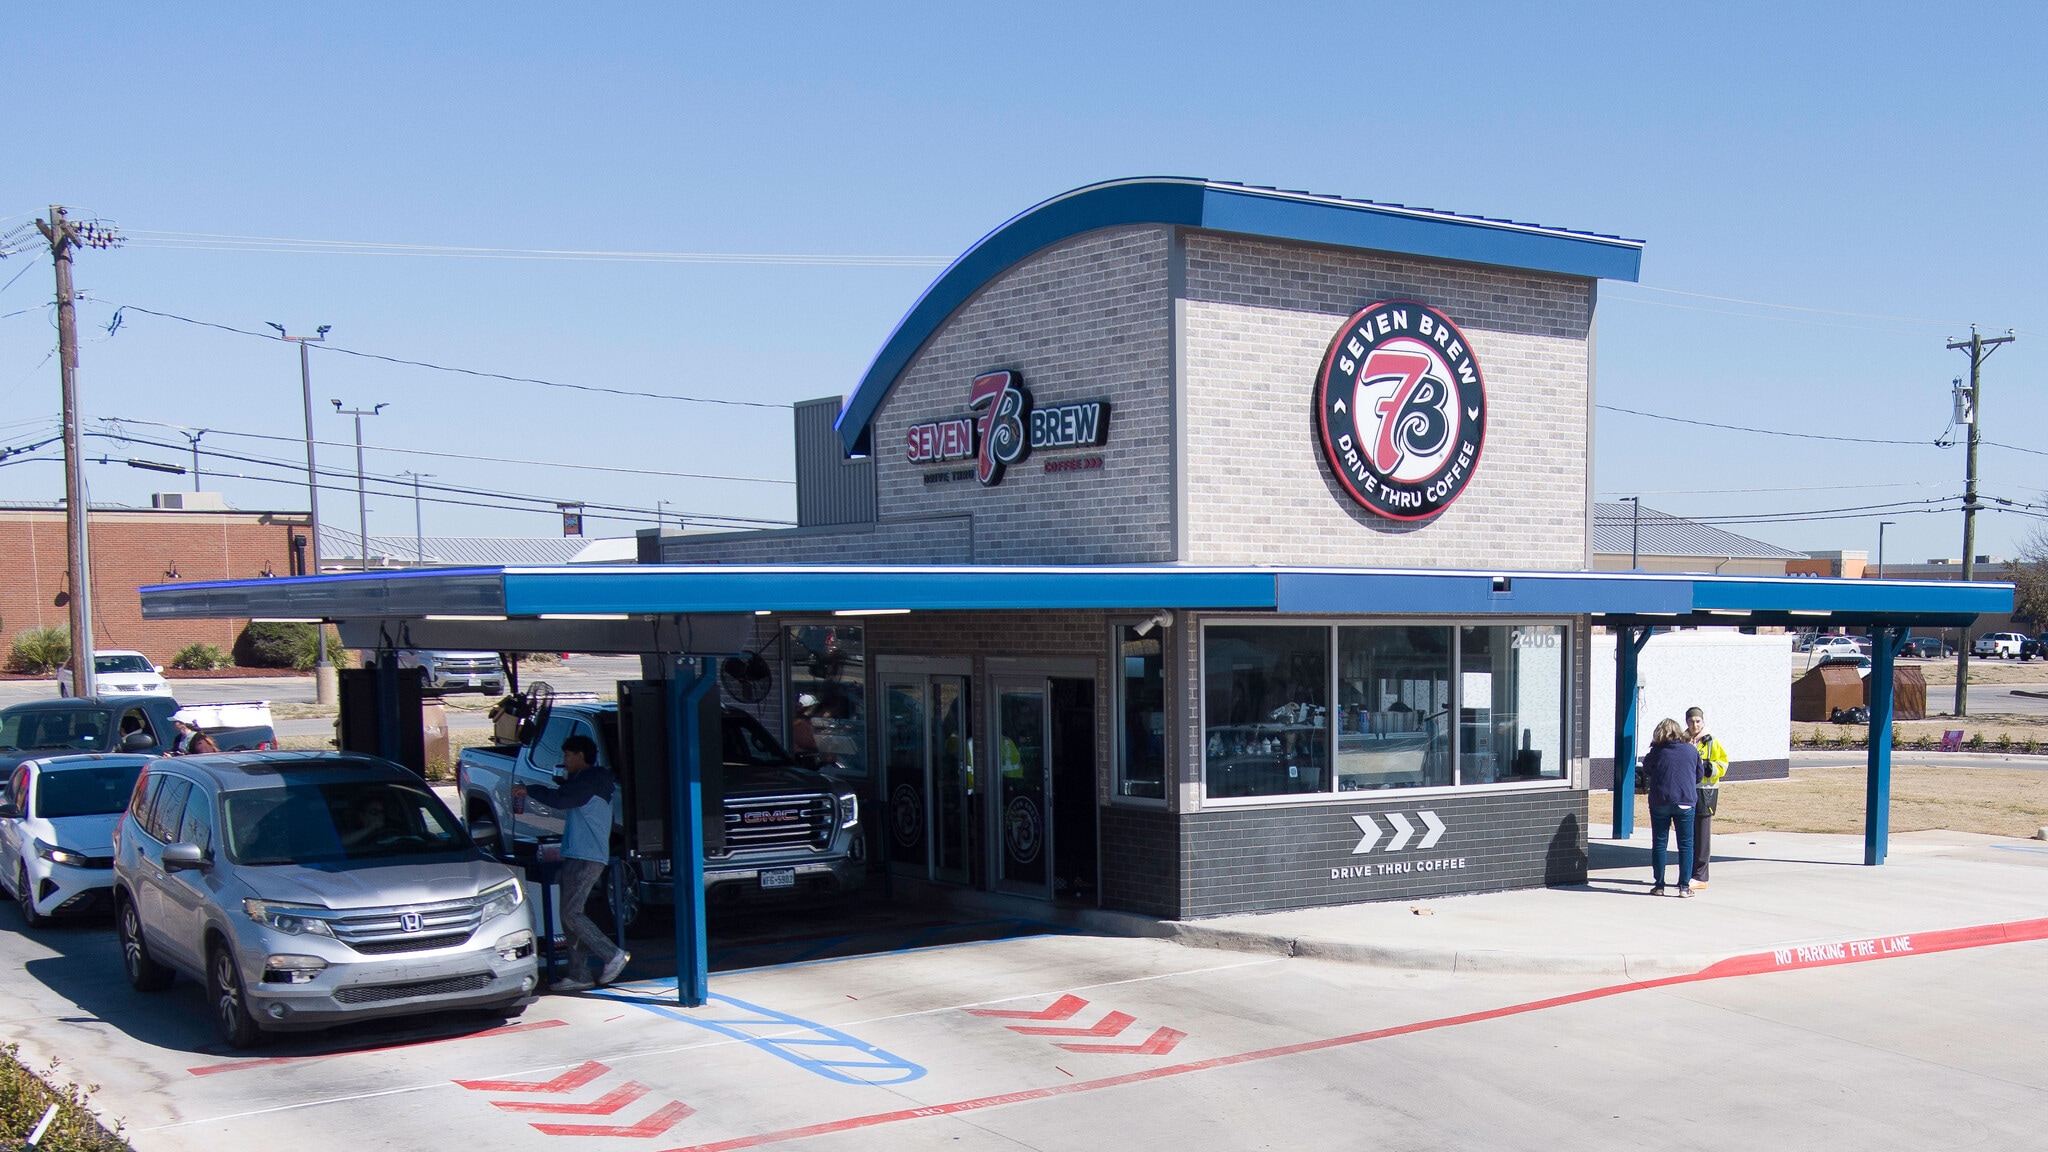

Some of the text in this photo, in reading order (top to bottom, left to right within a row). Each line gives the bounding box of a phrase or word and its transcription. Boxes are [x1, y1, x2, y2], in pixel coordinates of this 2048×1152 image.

[1339, 309, 1477, 385] SEVEN BREW
[906, 418, 973, 462] SEVEN
[1030, 402, 1101, 449] BREW
[924, 468, 975, 484] DRIVE THRU
[1044, 457, 1082, 474] COFFEE
[1338, 433, 1475, 508] DRIVE THRU COFFEE
[1511, 630, 1555, 649] 2406
[744, 809, 799, 824] GMC
[1331, 858, 1466, 880] DRIVE THRU COFFEE
[1773, 936, 1914, 966] NO PARKING FIRE LANE
[912, 1106, 945, 1118] NO
[956, 1091, 1041, 1112] PARKING
